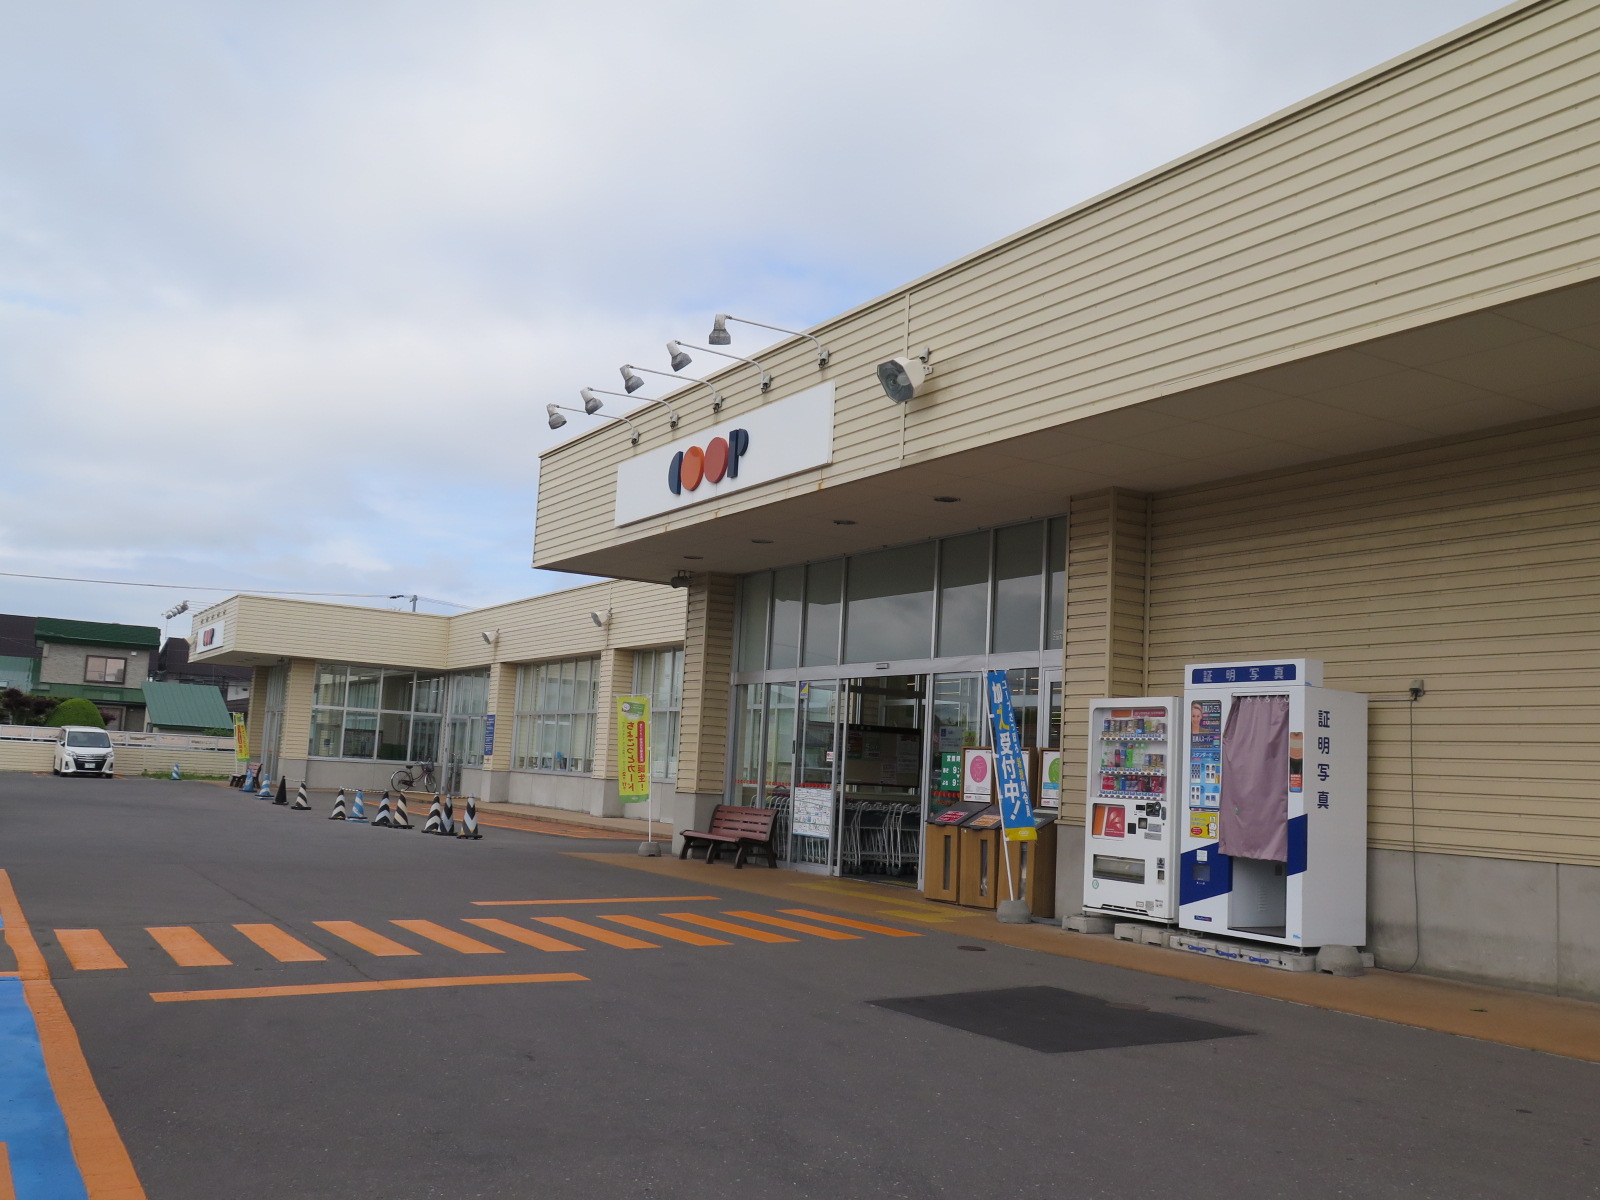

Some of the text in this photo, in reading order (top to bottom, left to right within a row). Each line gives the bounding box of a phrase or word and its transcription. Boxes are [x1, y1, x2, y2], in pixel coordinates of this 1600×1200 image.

[668, 428, 749, 495] COOP
[1203, 666, 1284, 682] 証明写真
[1316, 709, 1331, 810] 証明写真
